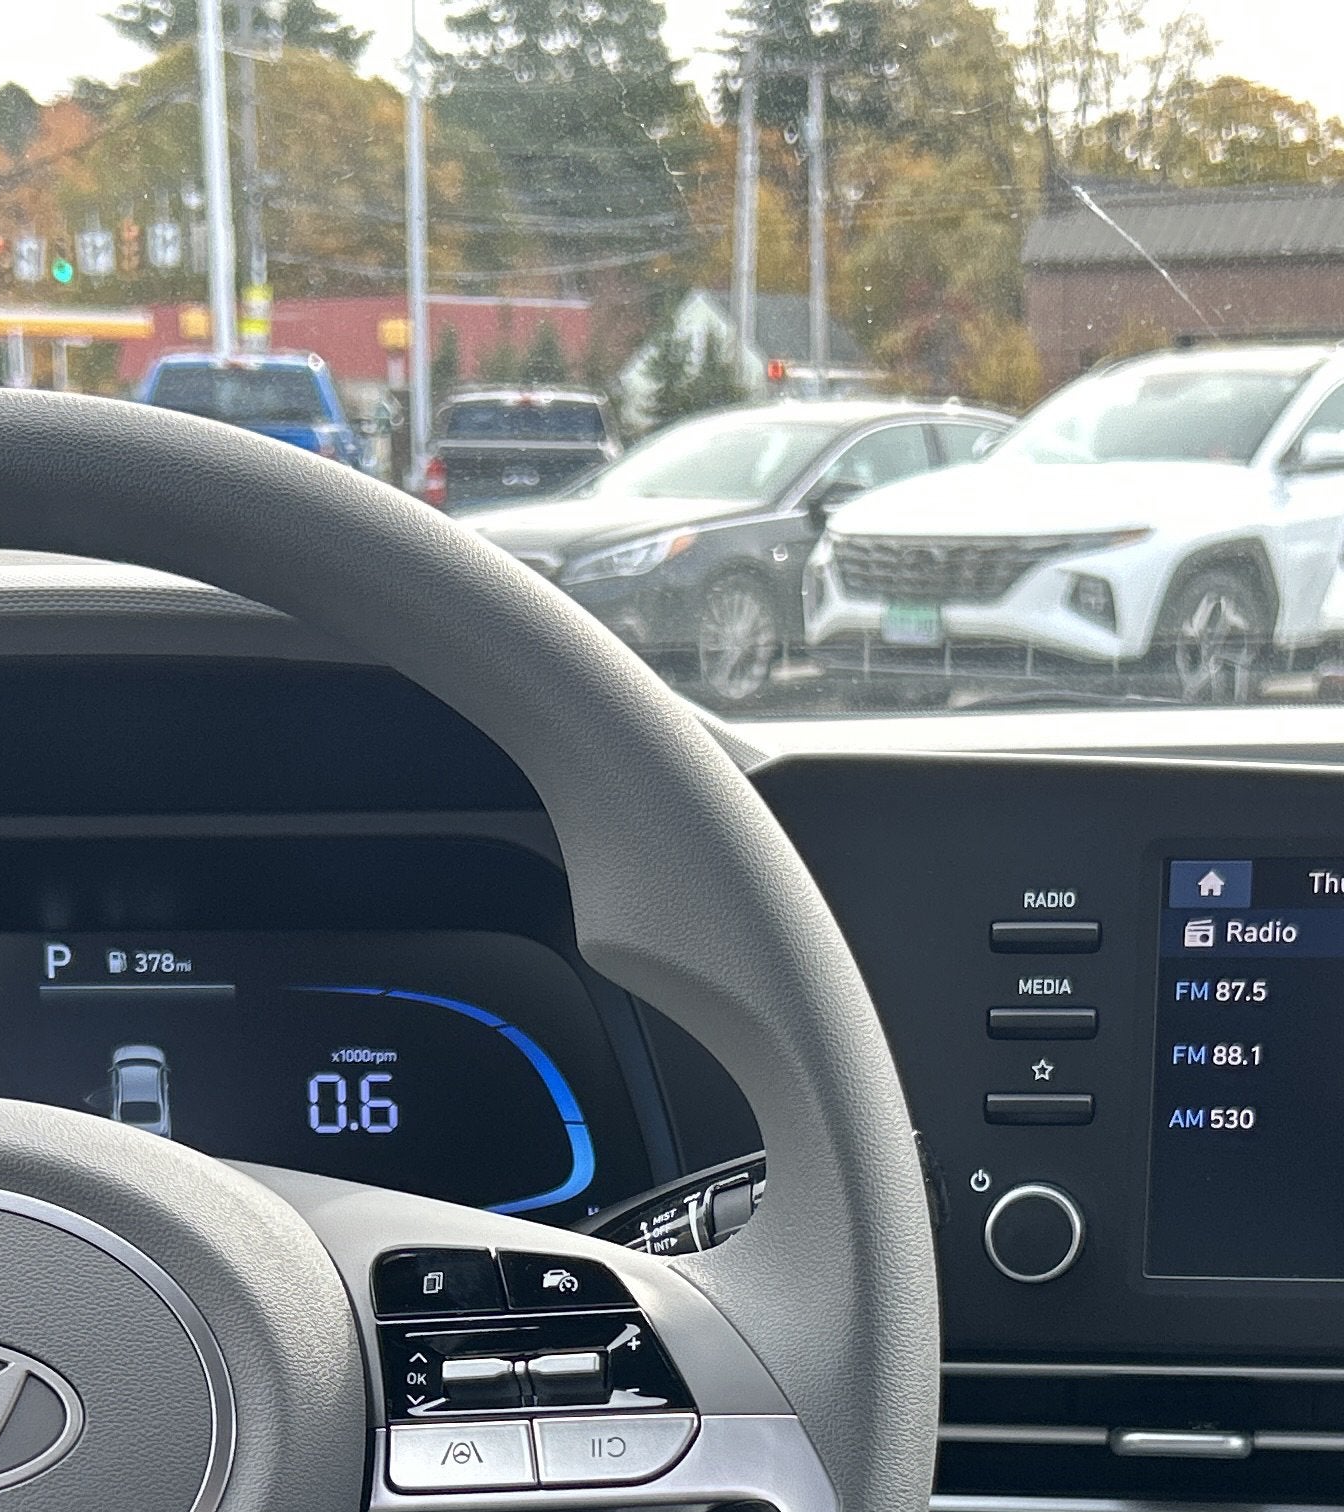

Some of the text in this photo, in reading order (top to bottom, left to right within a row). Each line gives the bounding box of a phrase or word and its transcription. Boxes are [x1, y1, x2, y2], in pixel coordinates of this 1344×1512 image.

[1023, 892, 1076, 908] RADIO
[1225, 920, 1298, 944] Radio
[47, 944, 72, 979] P
[1018, 978, 1071, 995] MEDIA
[1174, 980, 1268, 1003] FM 87.5
[330, 1048, 398, 1067] x1000rpm
[1171, 1044, 1261, 1066] FM 88.1
[307, 1073, 399, 1136] 0.6
[1168, 1109, 1255, 1130] AM 530
[652, 1208, 678, 1226] MIST
[653, 1238, 670, 1253] INT
[406, 1371, 427, 1386] OK
